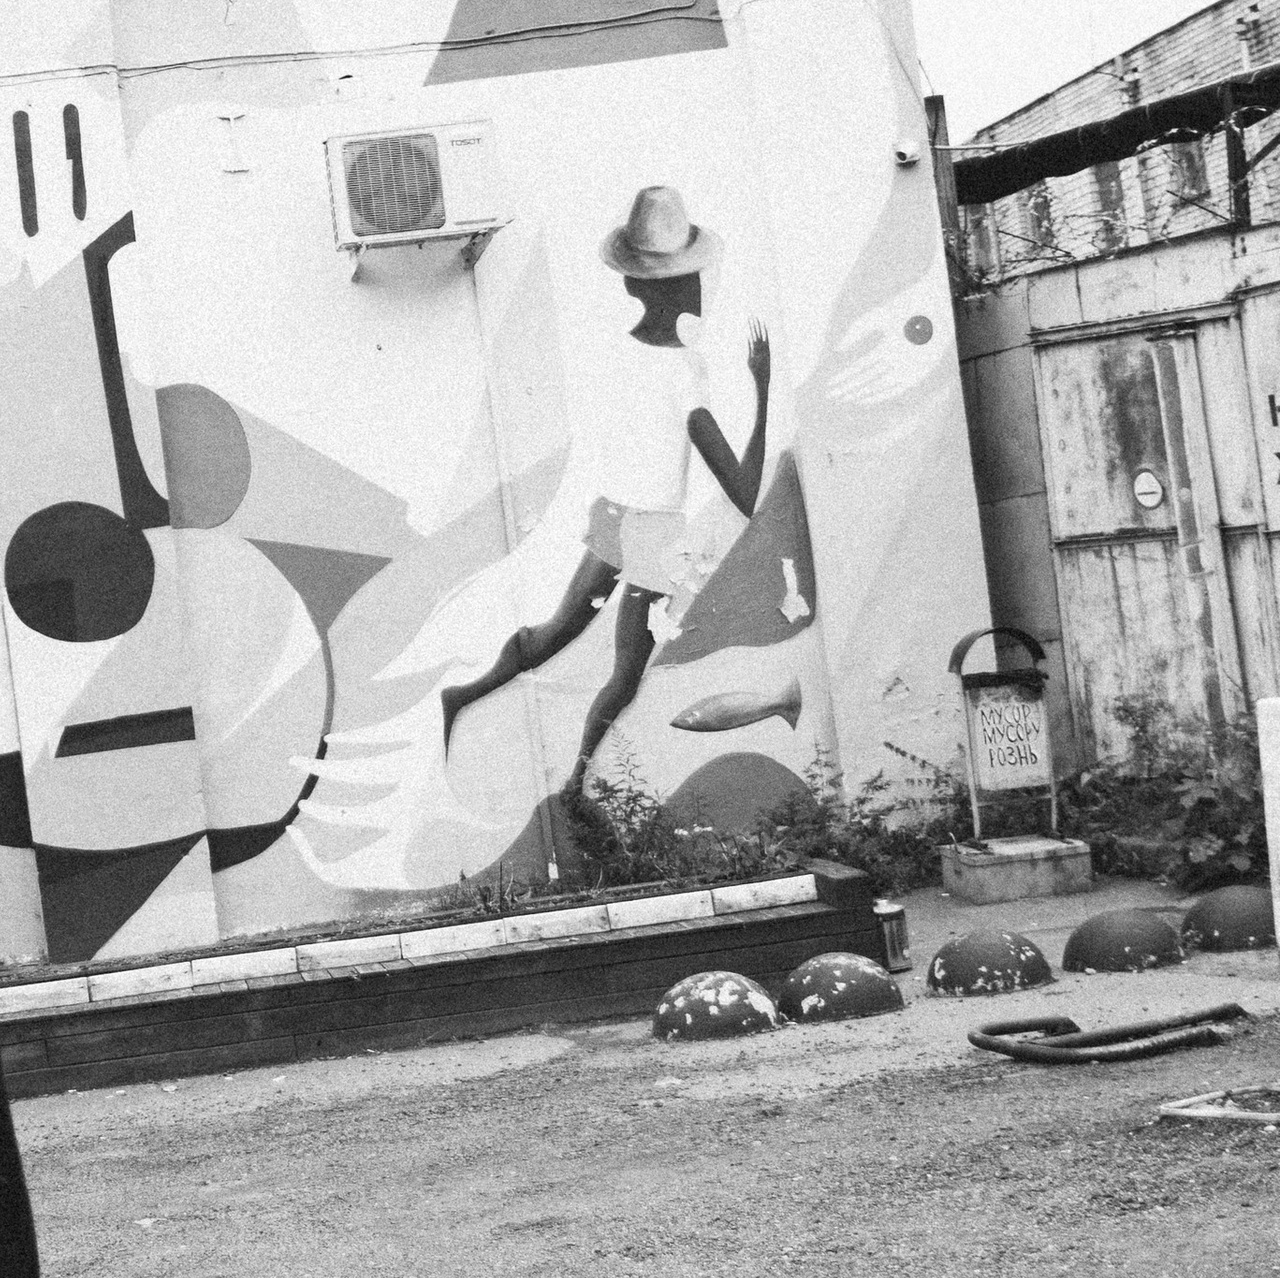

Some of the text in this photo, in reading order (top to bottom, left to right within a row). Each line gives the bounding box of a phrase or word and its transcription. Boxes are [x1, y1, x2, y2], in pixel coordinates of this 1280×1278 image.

[450, 138, 481, 146] TOSOT
[980, 704, 1031, 726] МУСОР
[983, 722, 1040, 744] МУСОРУ
[989, 744, 1038, 768] РОЗНЬ
